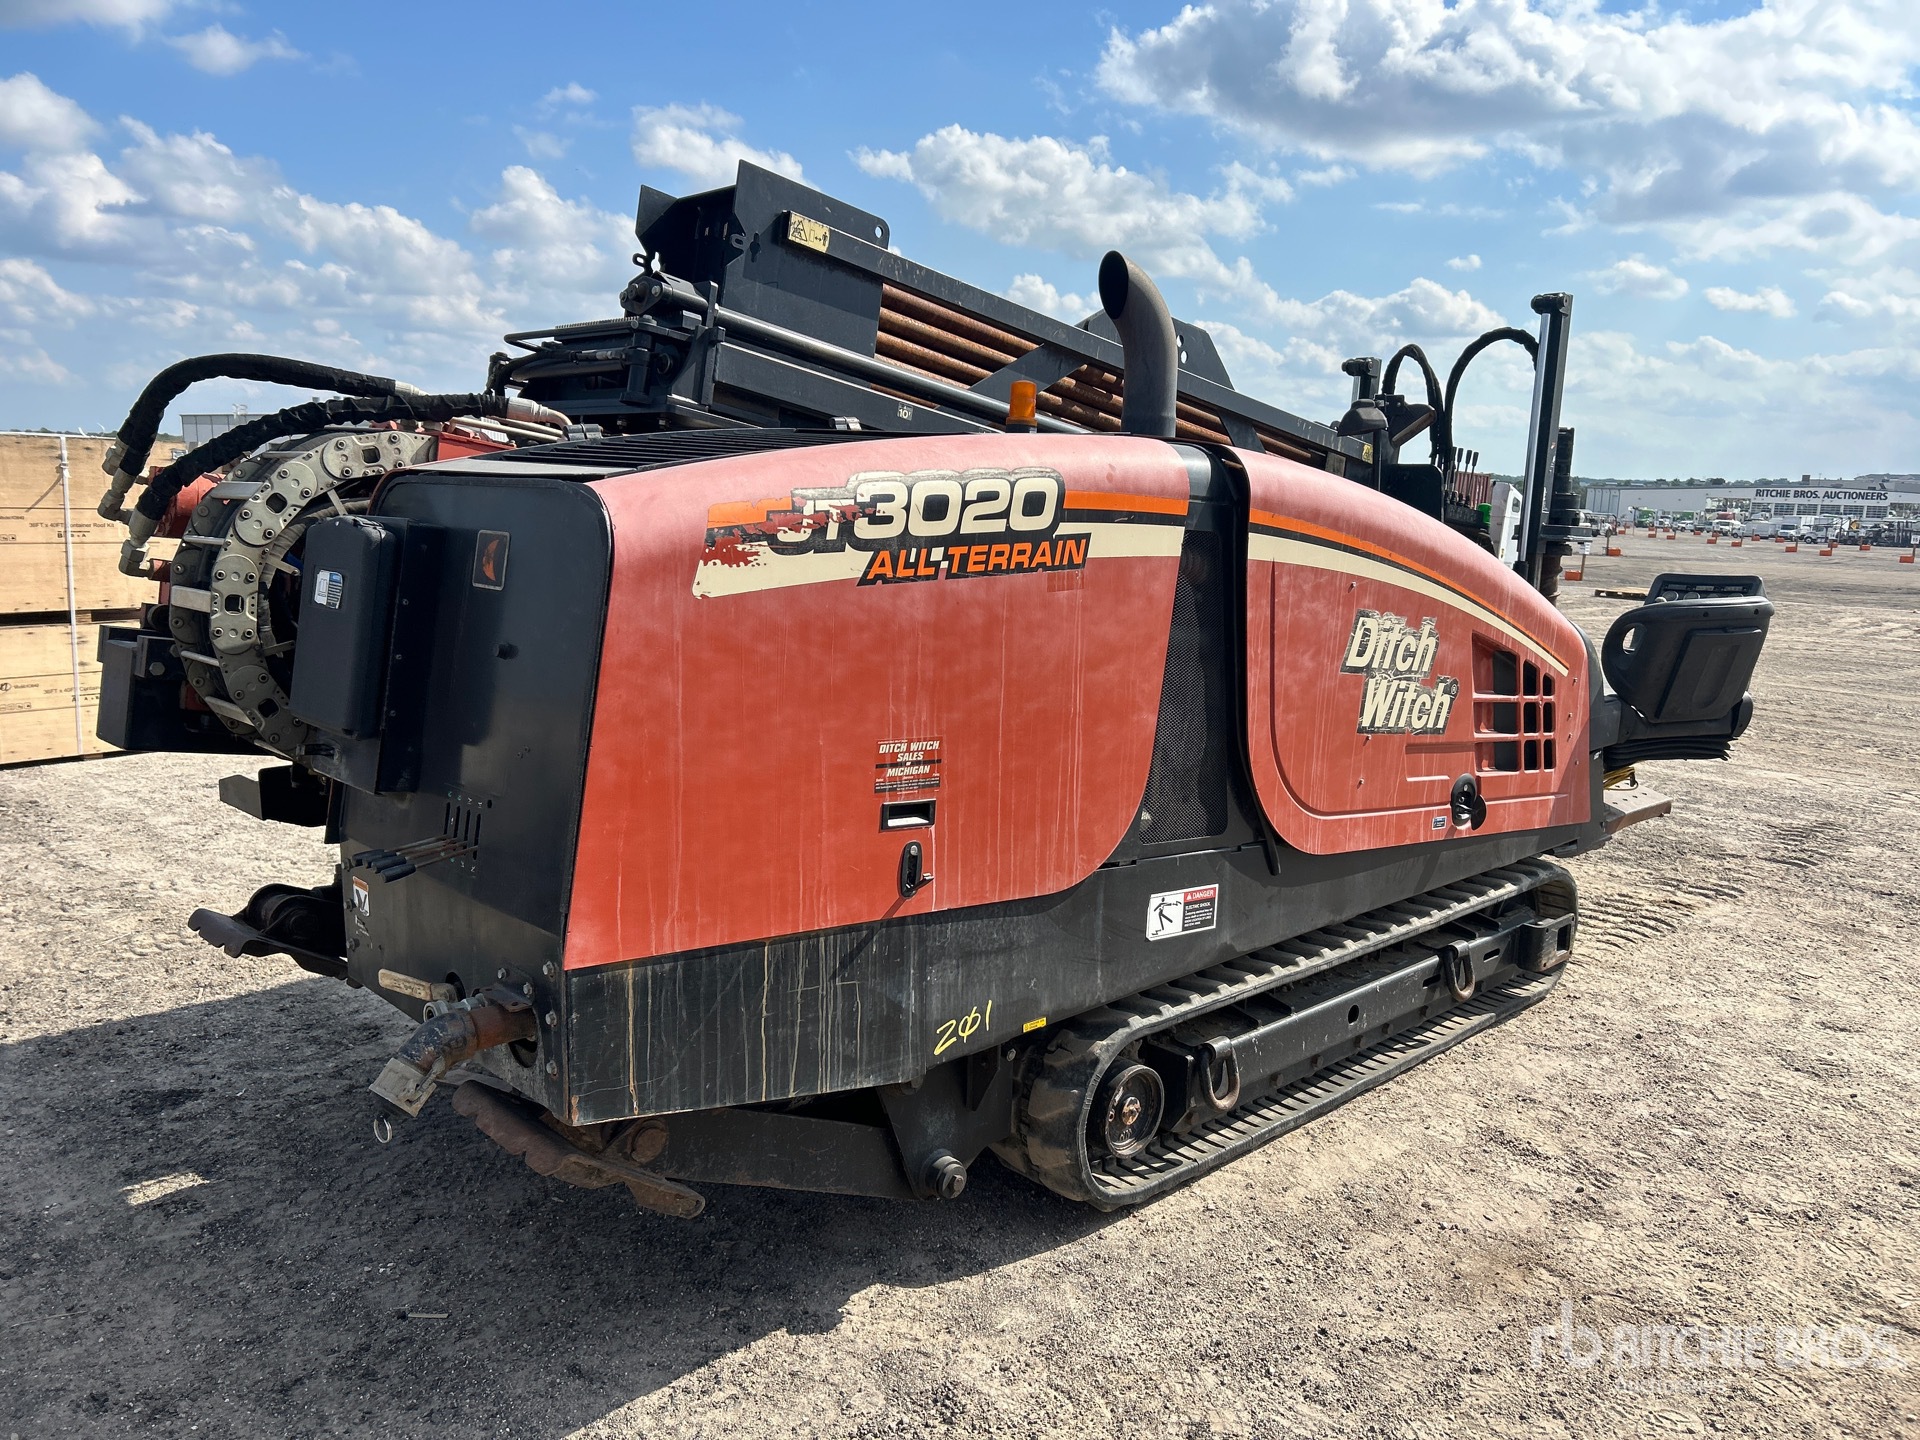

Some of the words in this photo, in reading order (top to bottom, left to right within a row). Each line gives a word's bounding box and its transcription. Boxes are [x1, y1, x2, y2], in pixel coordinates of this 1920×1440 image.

[1755, 488, 1791, 498] RITCHIE
[1793, 489, 1820, 499] BROS.
[1823, 490, 1888, 500] AUCTIONEERS
[866, 550, 937, 580] ALL
[947, 538, 1087, 574] TERRAIN
[1345, 616, 1436, 672] Ditch
[1361, 678, 1451, 729] Witch
[879, 742, 908, 754] DITCH
[910, 740, 940, 752] WITCH
[897, 751, 924, 762] SALES
[886, 765, 931, 777] MICHIGAN
[1192, 889, 1214, 900] DANGER
